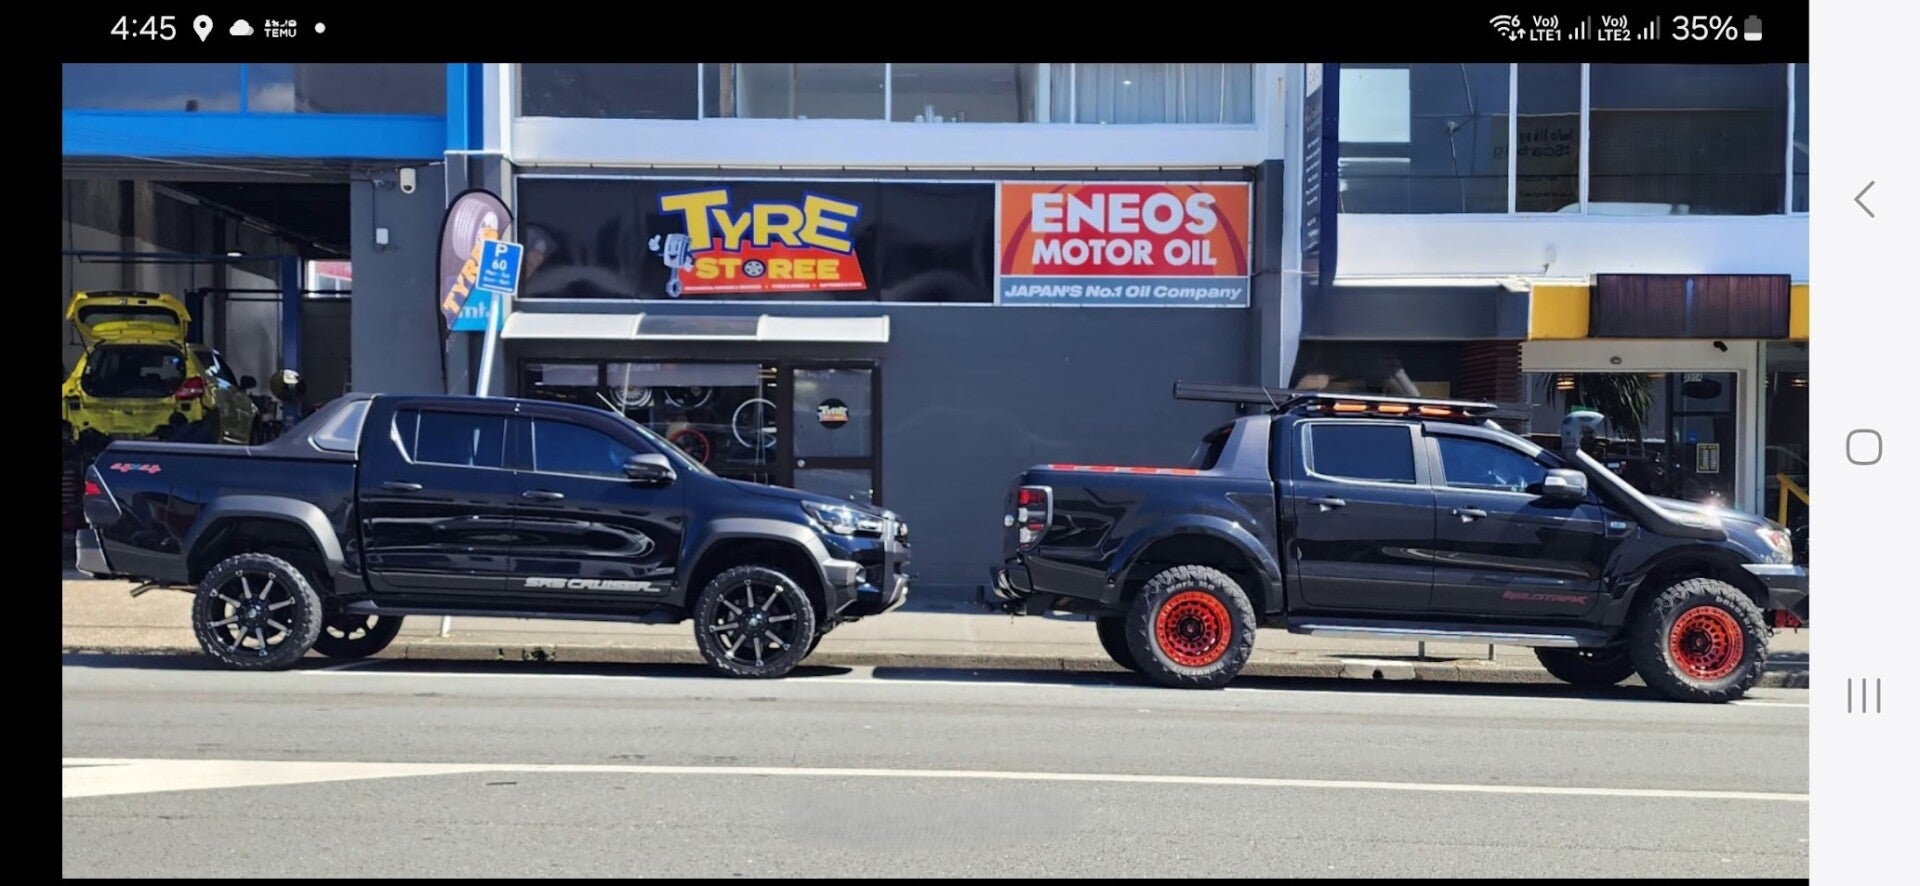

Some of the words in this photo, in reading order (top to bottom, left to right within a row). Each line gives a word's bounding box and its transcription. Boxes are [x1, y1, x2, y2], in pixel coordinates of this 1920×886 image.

[660, 188, 858, 252] TYRE
[1031, 192, 1218, 235] ENEOS
[495, 243, 508, 257] P
[1031, 238, 1154, 266] MOTOR
[1163, 238, 1217, 266] OIL
[492, 259, 507, 271] 60
[1005, 285, 1083, 298] JAPAN'S
[1085, 285, 1122, 298] No.1
[1125, 285, 1150, 298] Oil
[1153, 285, 1242, 300] Company
